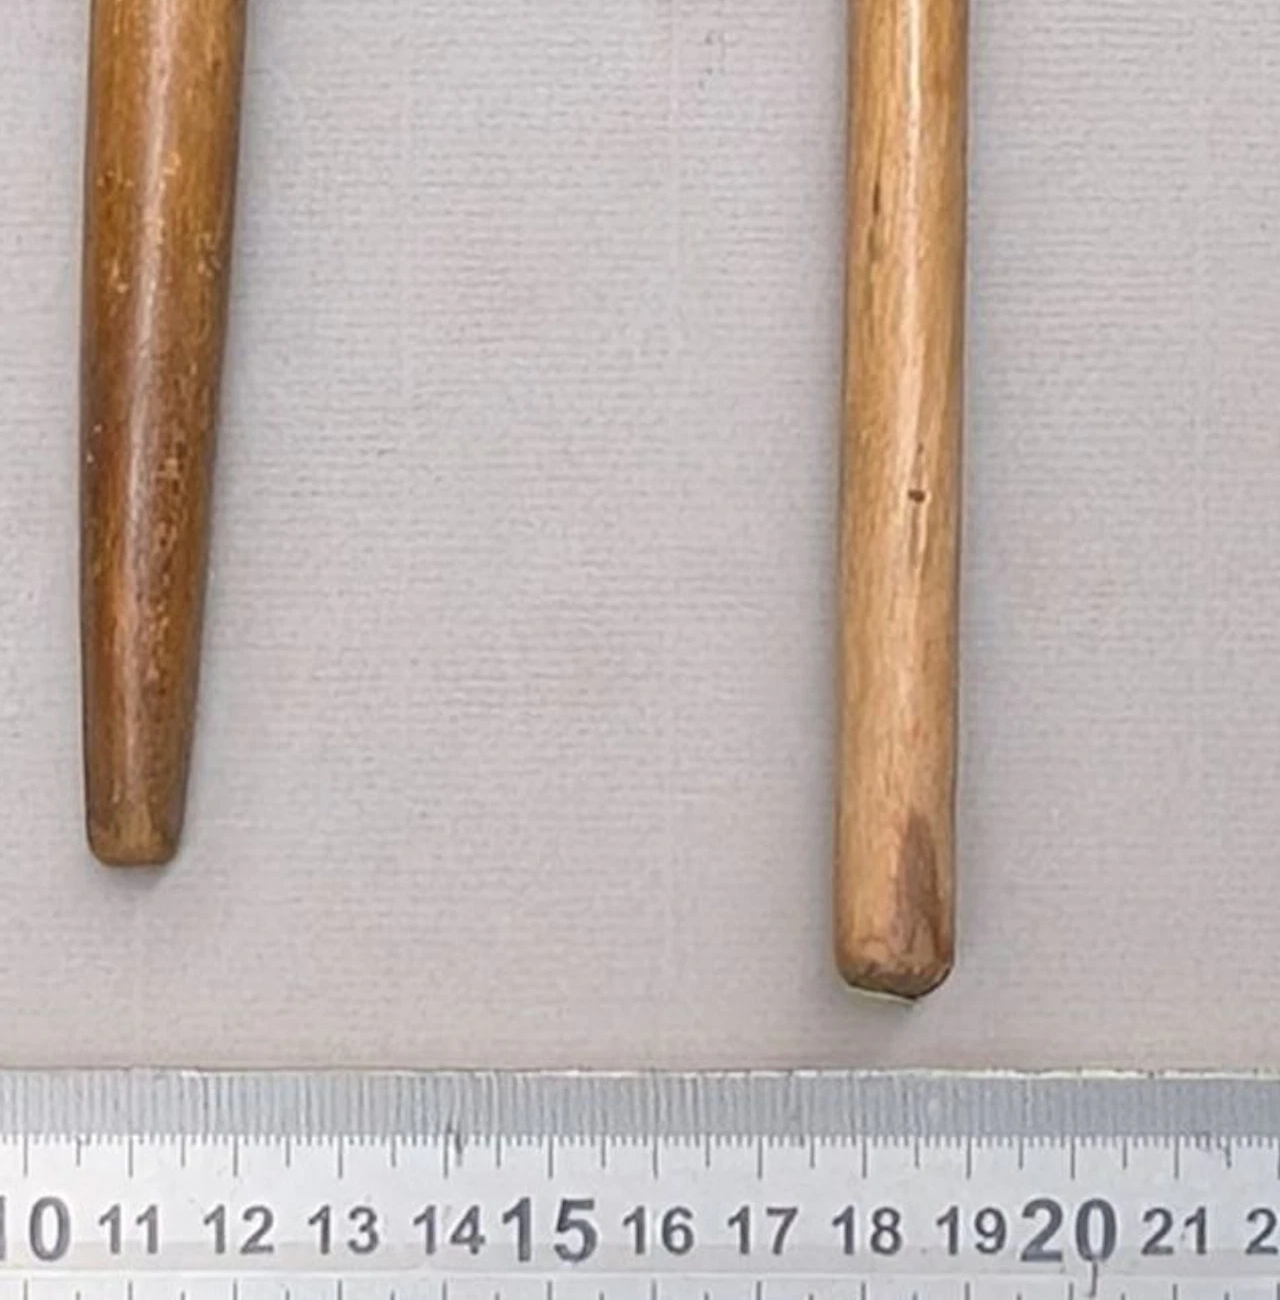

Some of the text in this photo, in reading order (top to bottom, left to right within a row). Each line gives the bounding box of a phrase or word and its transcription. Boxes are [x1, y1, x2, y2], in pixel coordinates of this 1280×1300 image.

[98, 1204, 158, 1254] 11
[203, 1204, 274, 1255] 12
[308, 1204, 379, 1255] 13
[413, 1205, 486, 1256] 14
[502, 1197, 597, 1264] 15
[622, 1205, 694, 1256] 16
[728, 1205, 798, 1256] 17
[832, 1205, 902, 1256] 18
[936, 1206, 1007, 1256] 19
[1020, 1198, 1116, 1264] 20
[1141, 1206, 1207, 1256] 21
